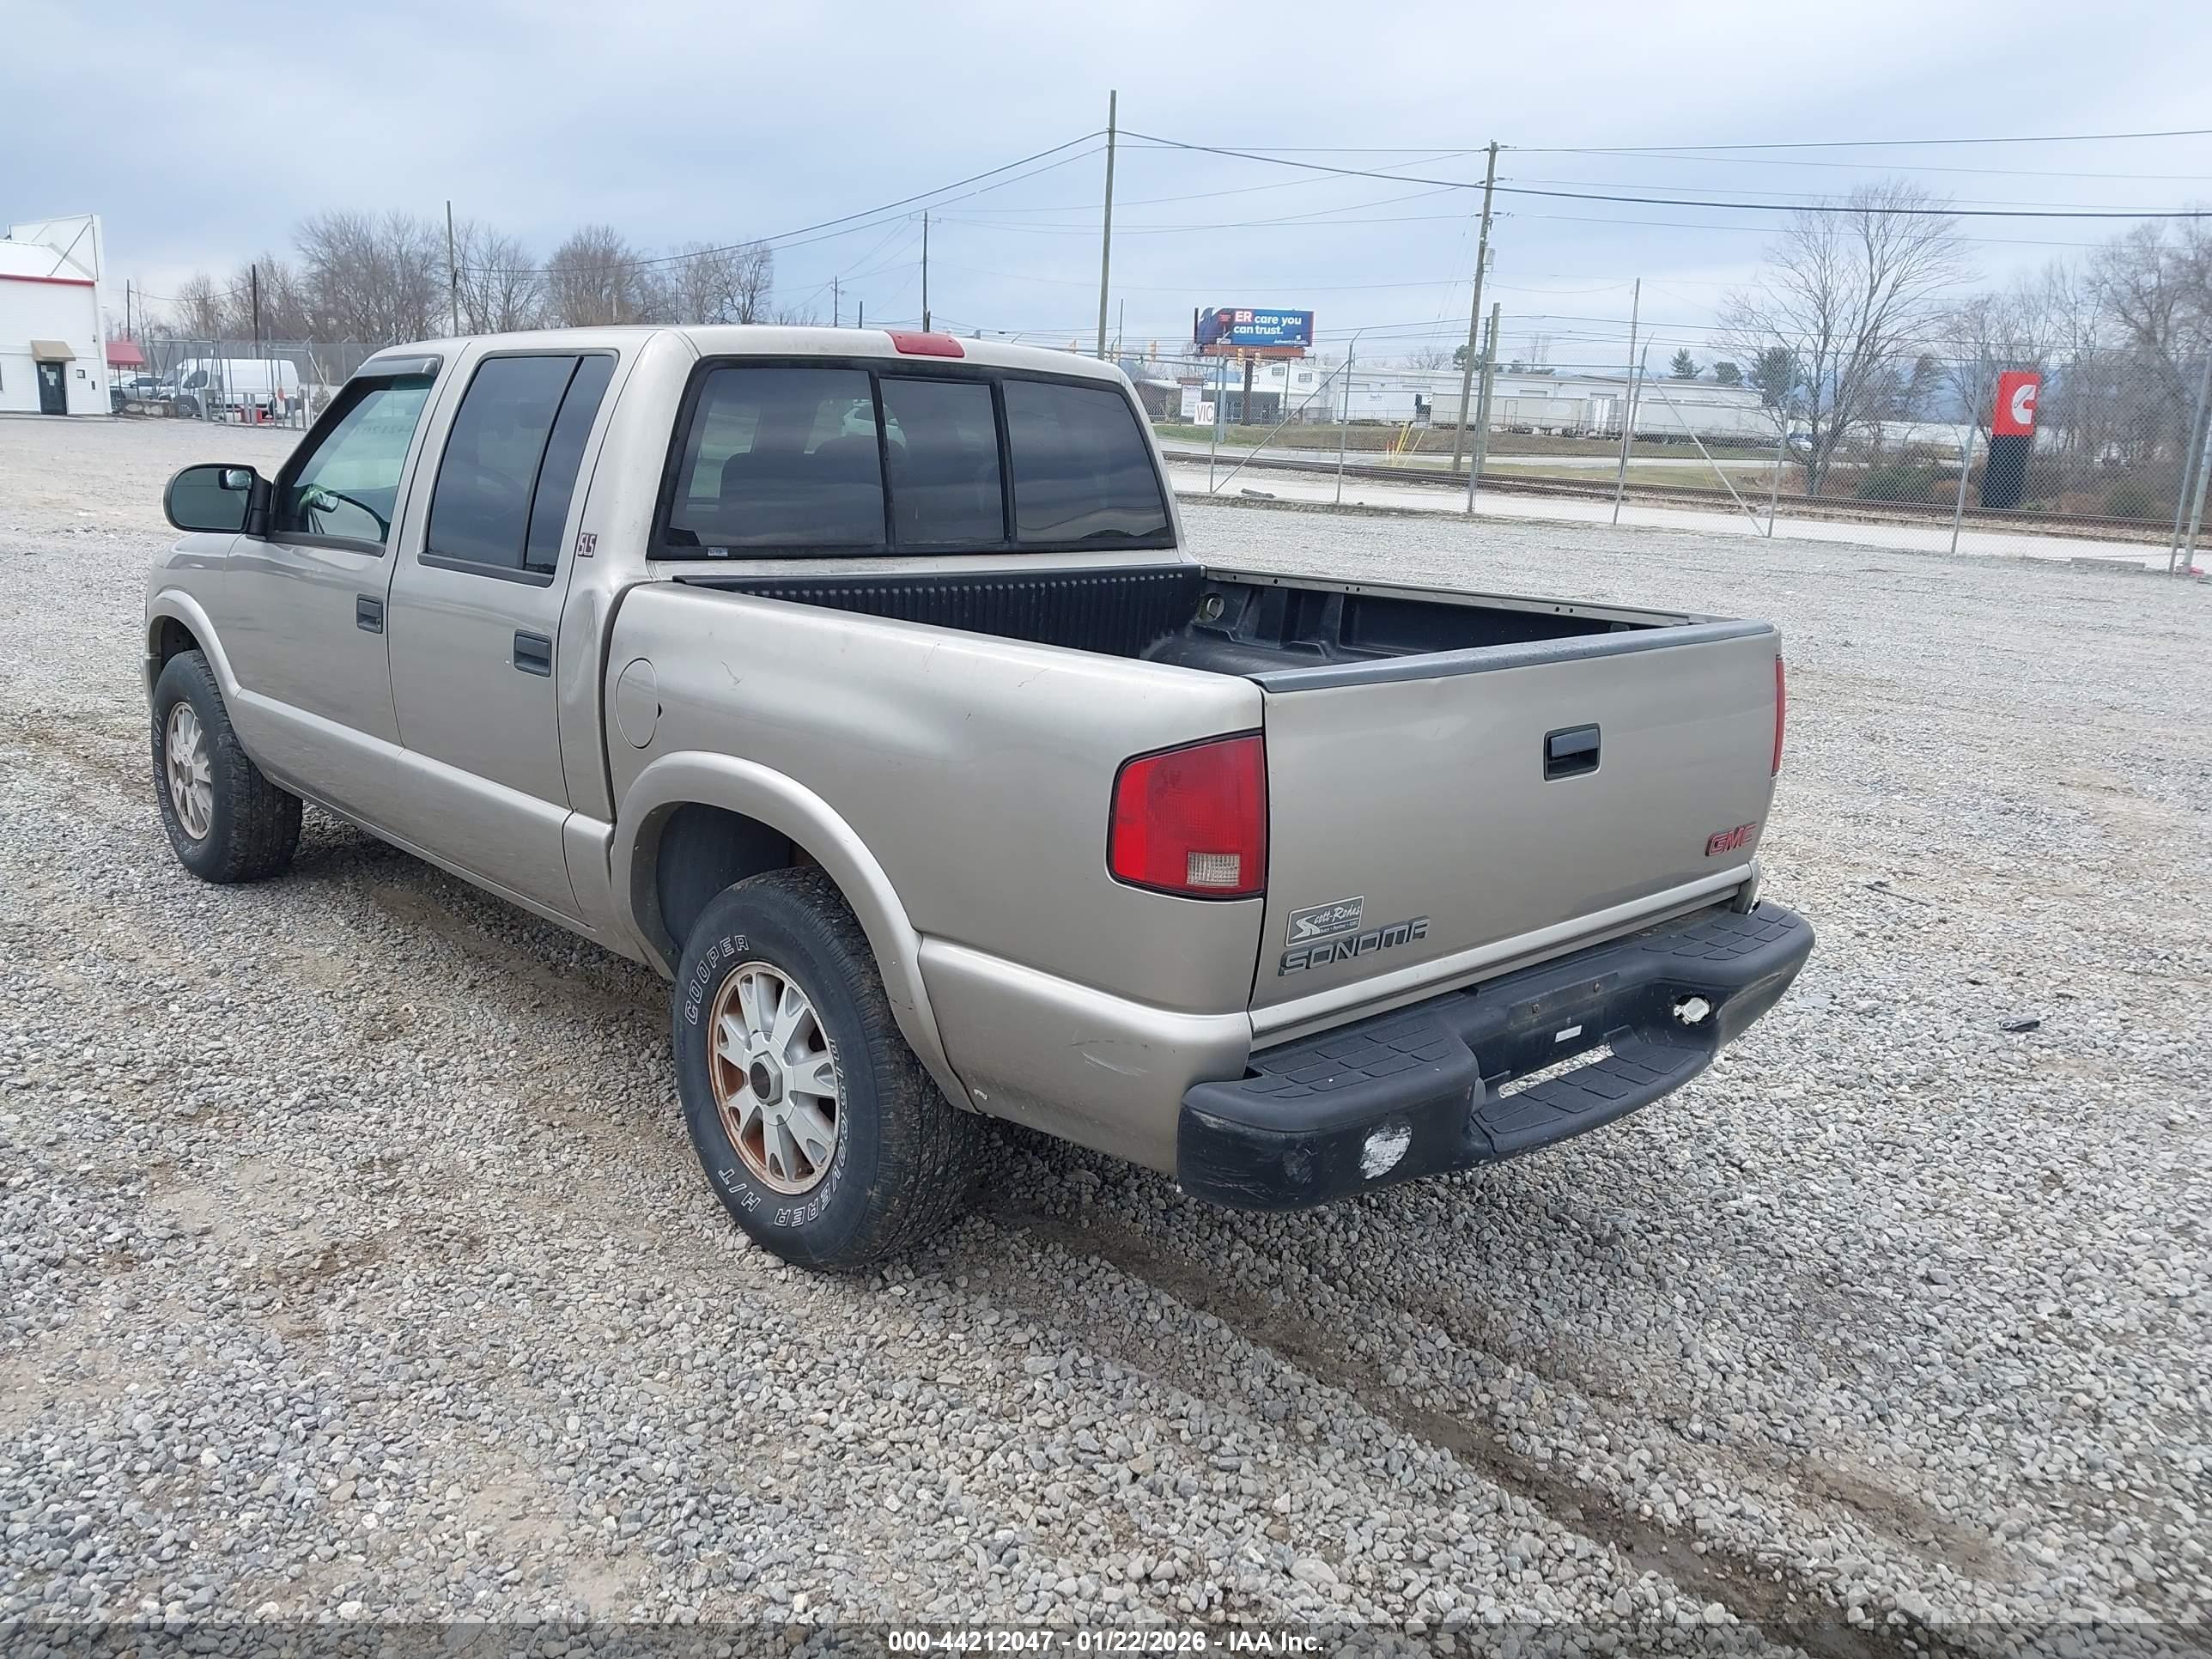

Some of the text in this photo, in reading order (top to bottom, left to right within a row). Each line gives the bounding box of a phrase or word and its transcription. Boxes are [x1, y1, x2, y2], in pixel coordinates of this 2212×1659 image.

[1233, 325, 1284, 334] can trust.
[1235, 311, 1252, 322] ER
[1281, 316, 1302, 326] you
[1196, 404, 1214, 422] VIC
[578, 533, 597, 557] SLS
[1705, 822, 1757, 856] GMC
[1278, 915, 1431, 976] SONOMA
[685, 935, 750, 1024] COOPER
[774, 1037, 849, 1227] DISCOVERER
[718, 1169, 762, 1212] H/T
